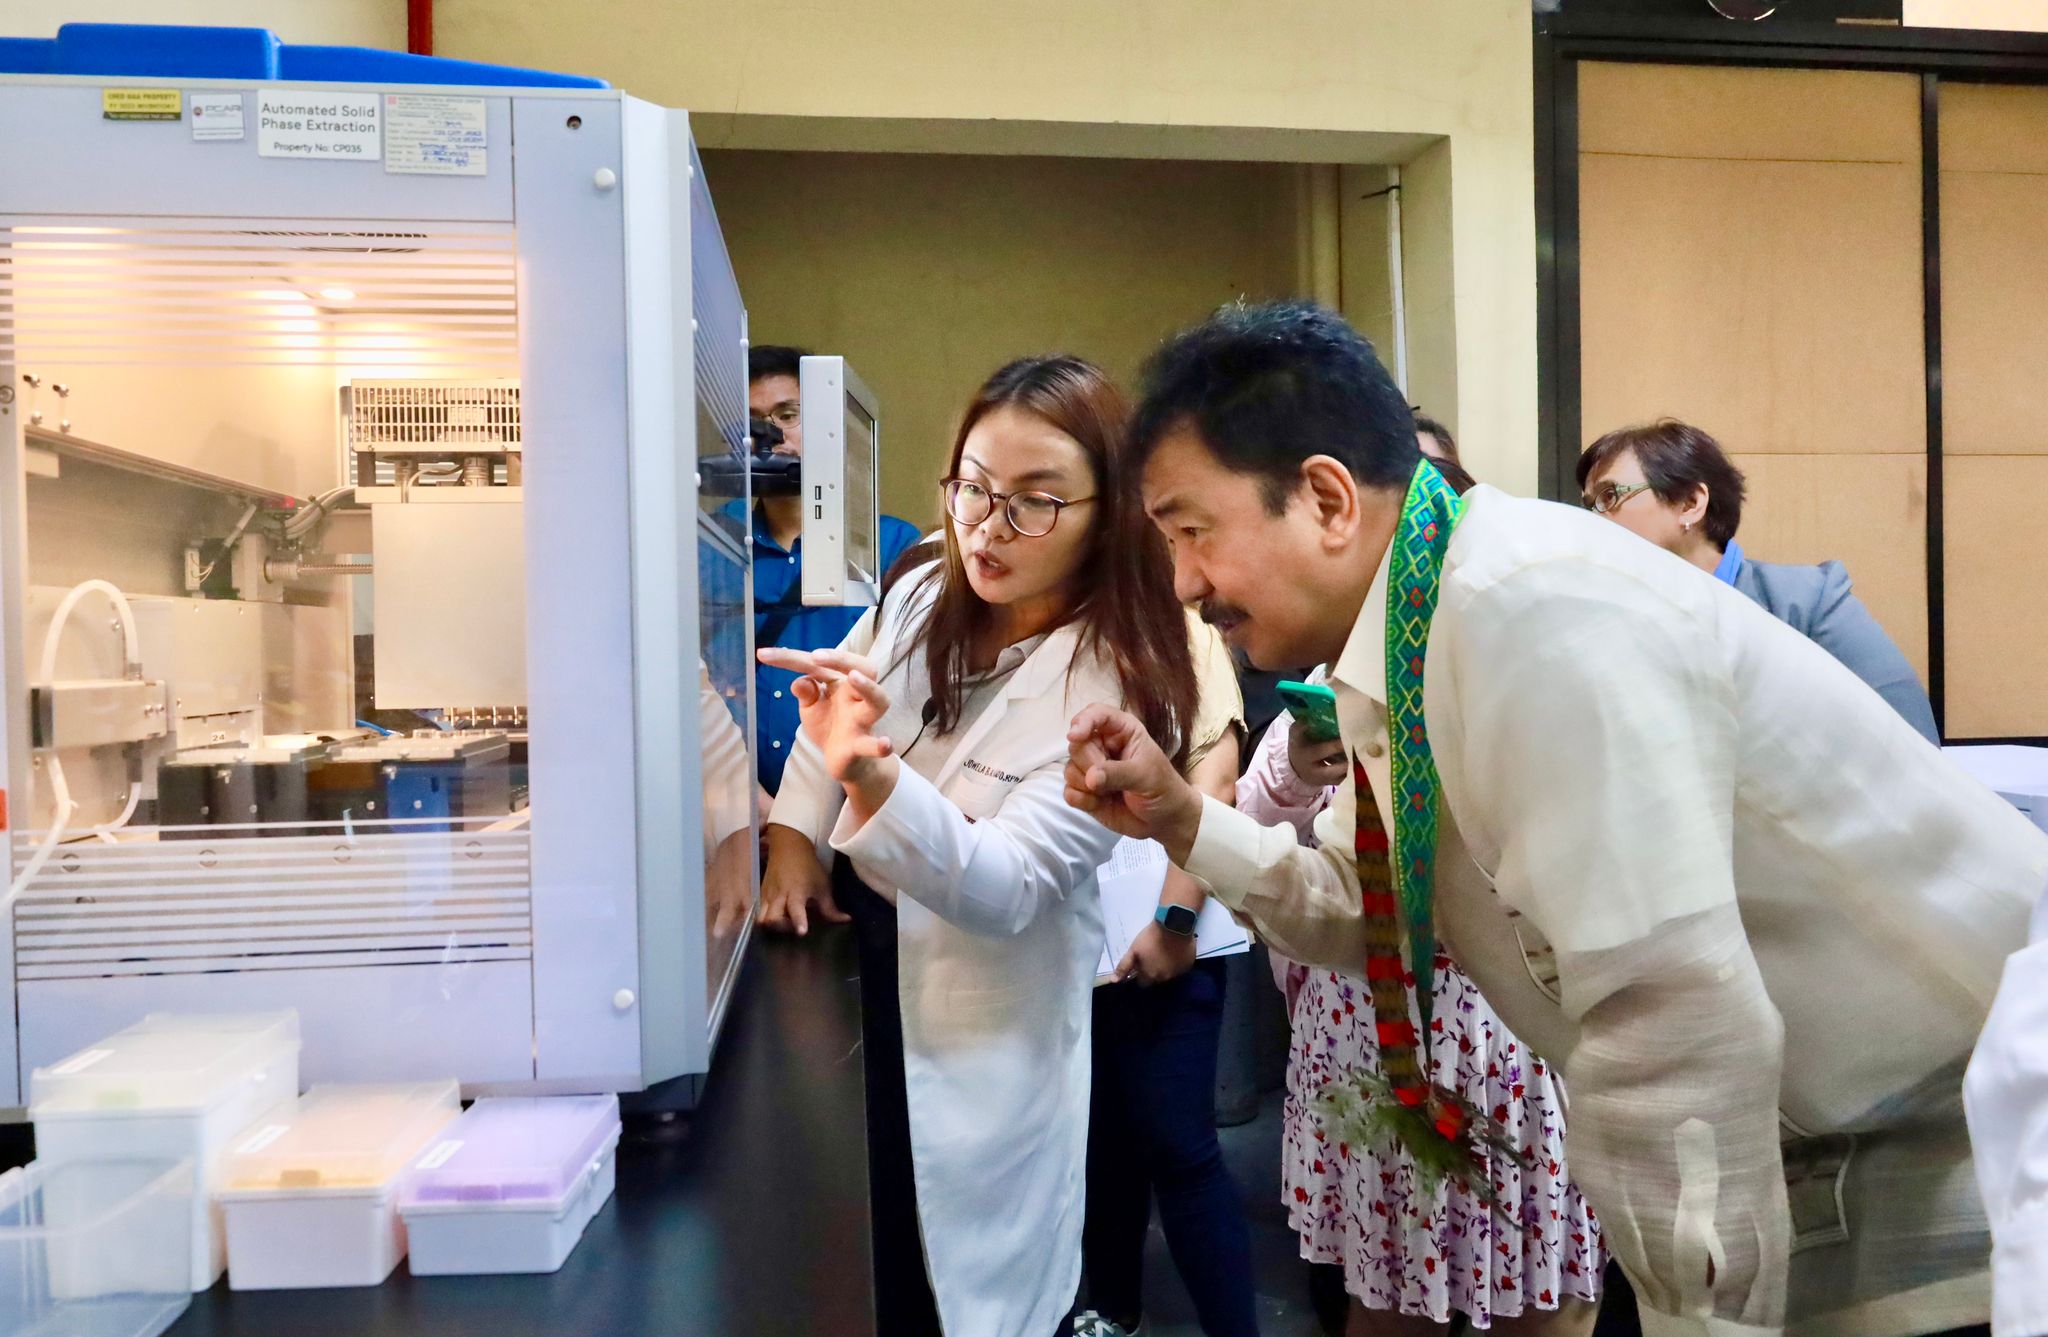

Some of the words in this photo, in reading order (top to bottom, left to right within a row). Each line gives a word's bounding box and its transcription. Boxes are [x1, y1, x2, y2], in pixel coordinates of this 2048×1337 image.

[261, 102, 337, 116] Automated
[341, 105, 375, 118] Solid
[261, 118, 302, 131] Phase
[306, 119, 376, 133] Extraction
[273, 141, 313, 154] Property
[315, 143, 330, 153] No:
[332, 143, 363, 154] CP035
